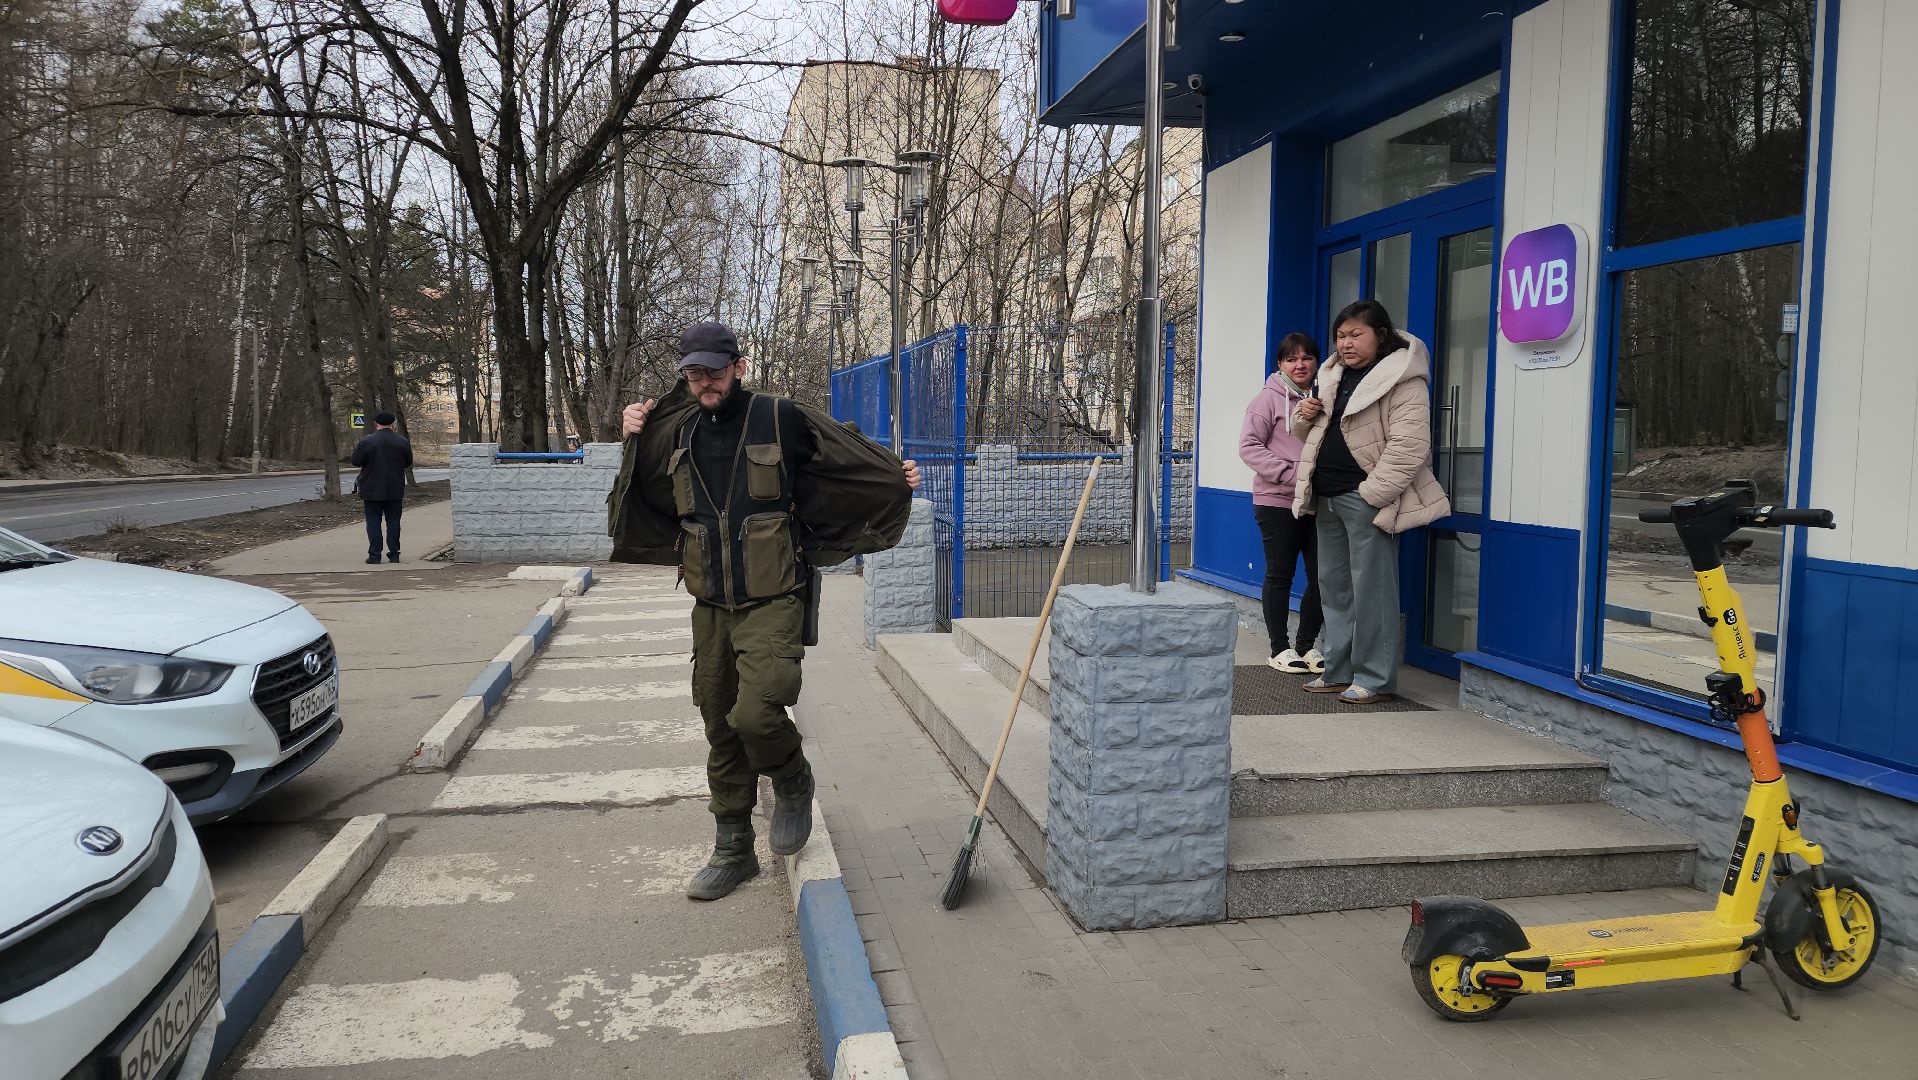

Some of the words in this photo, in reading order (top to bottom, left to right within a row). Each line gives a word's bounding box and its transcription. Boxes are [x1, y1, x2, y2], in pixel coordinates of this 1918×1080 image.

[1508, 258, 1568, 310] WB
[1727, 609, 1736, 624] Go
[1732, 626, 1746, 660] Яндекс
[194, 944, 216, 996] 750
